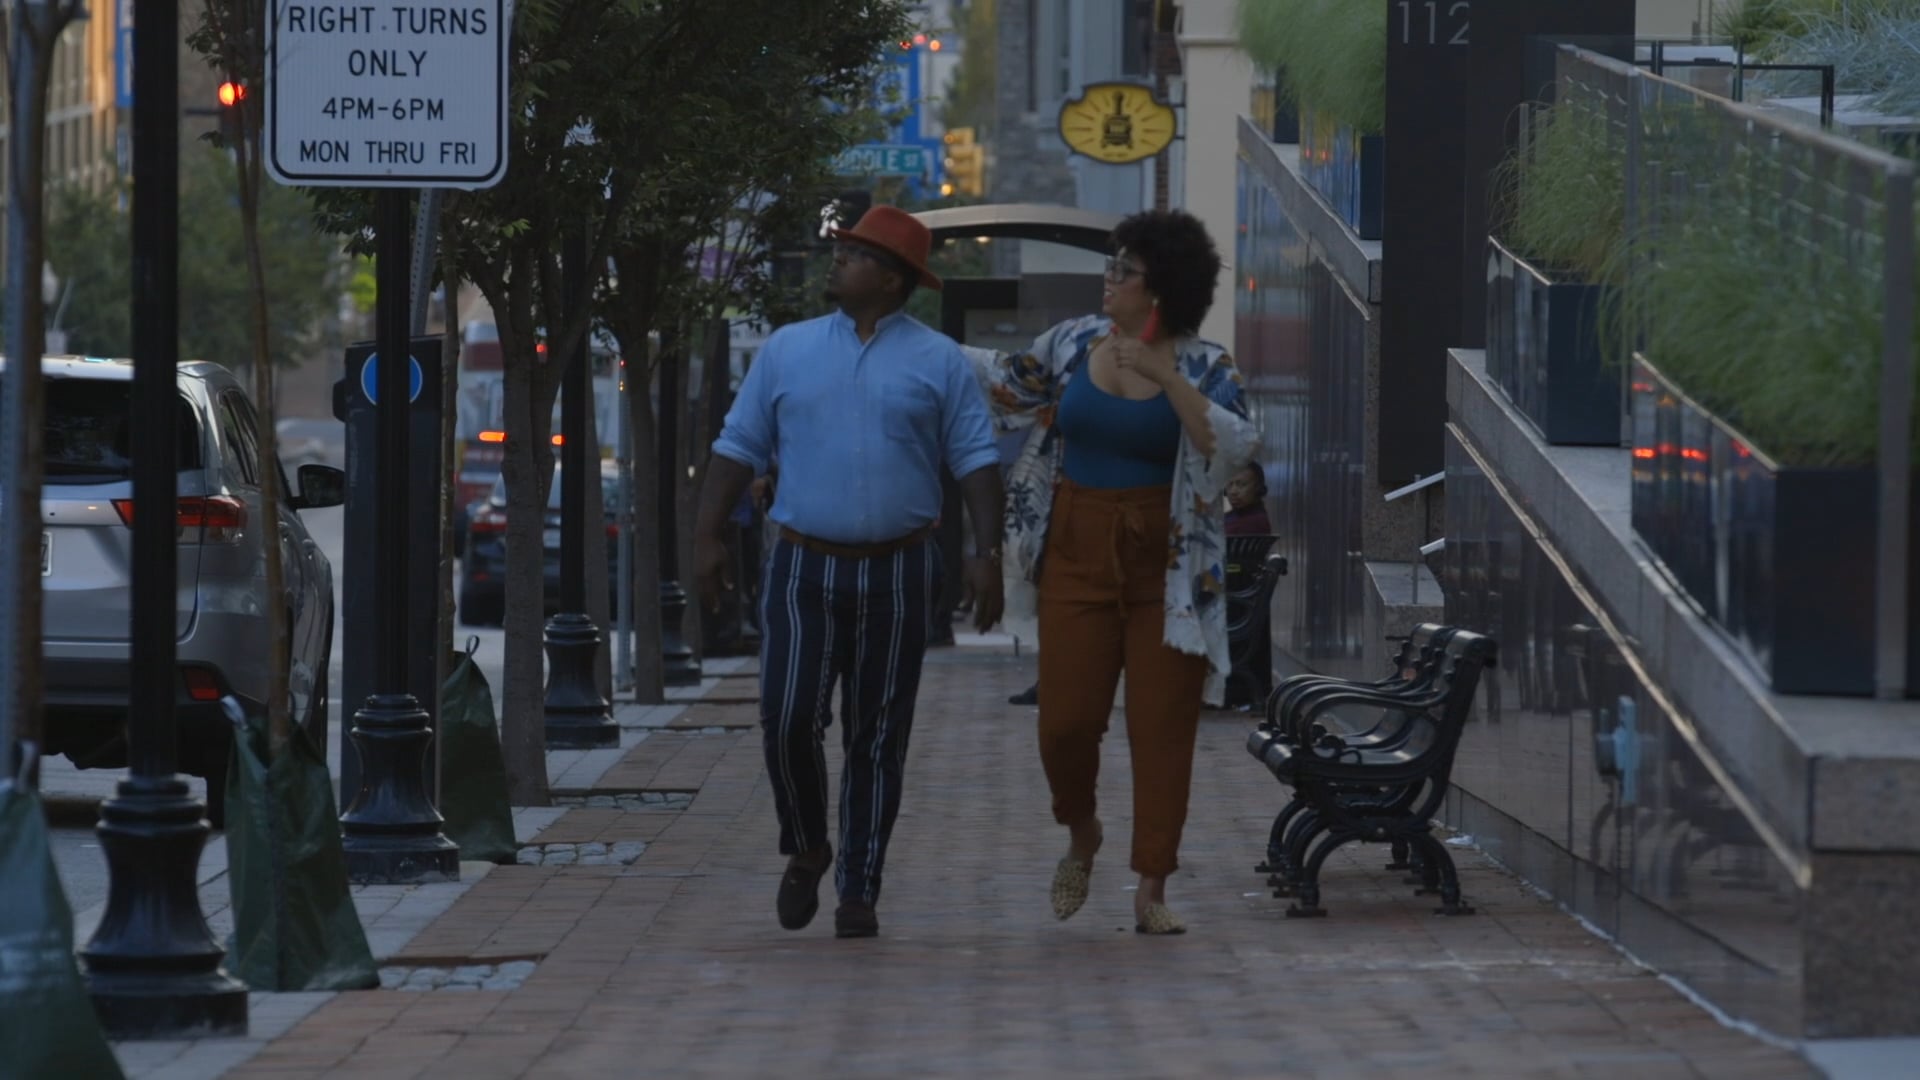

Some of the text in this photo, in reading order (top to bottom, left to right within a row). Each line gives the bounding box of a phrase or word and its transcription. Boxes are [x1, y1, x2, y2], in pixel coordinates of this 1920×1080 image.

[289, 6, 487, 35] RIGHT TURNS
[1397, 1, 1470, 44] 112
[348, 49, 427, 77] ONLY
[322, 97, 445, 120] 4PM-6PM
[300, 140, 476, 165] MON THRU FRI
